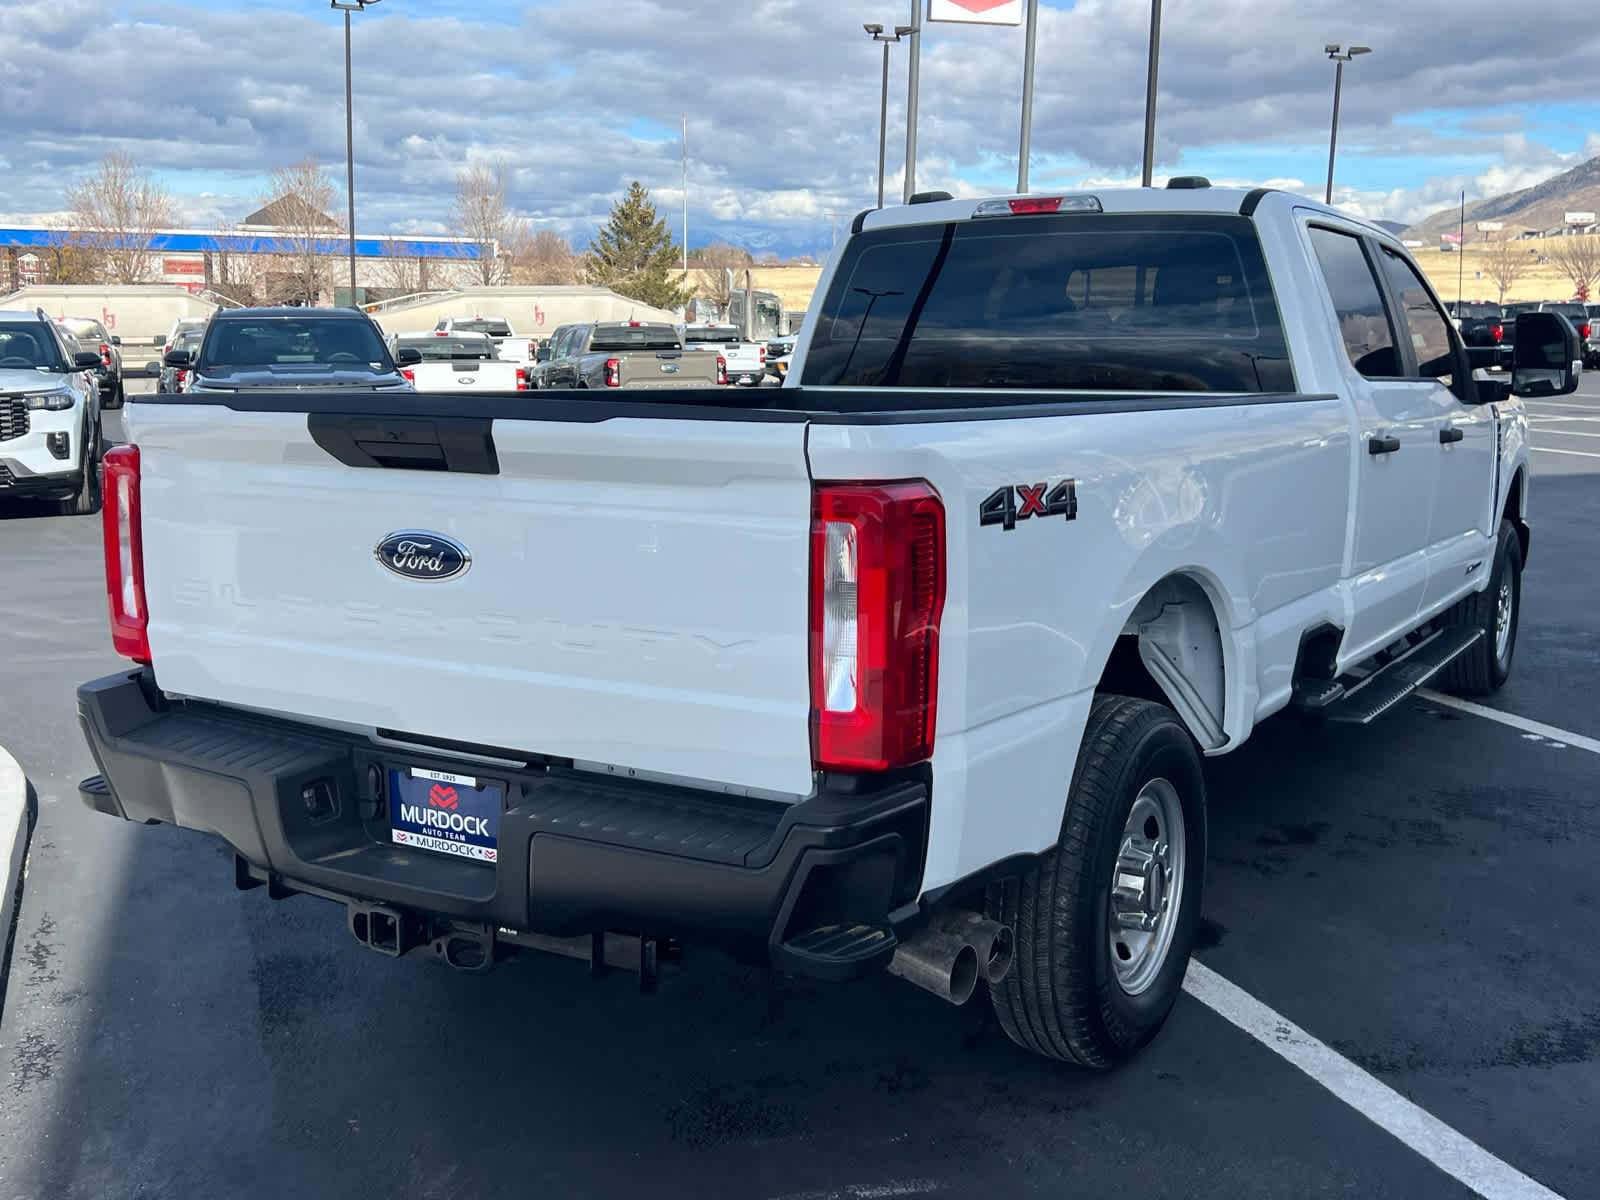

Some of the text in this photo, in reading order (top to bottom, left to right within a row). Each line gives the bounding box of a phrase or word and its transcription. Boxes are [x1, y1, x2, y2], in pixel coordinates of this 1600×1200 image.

[393, 540, 445, 572] Ford
[400, 803, 490, 837] MURDOCK
[416, 836, 476, 857] MURDOCK
[422, 827, 466, 842] AUTO TEAM
